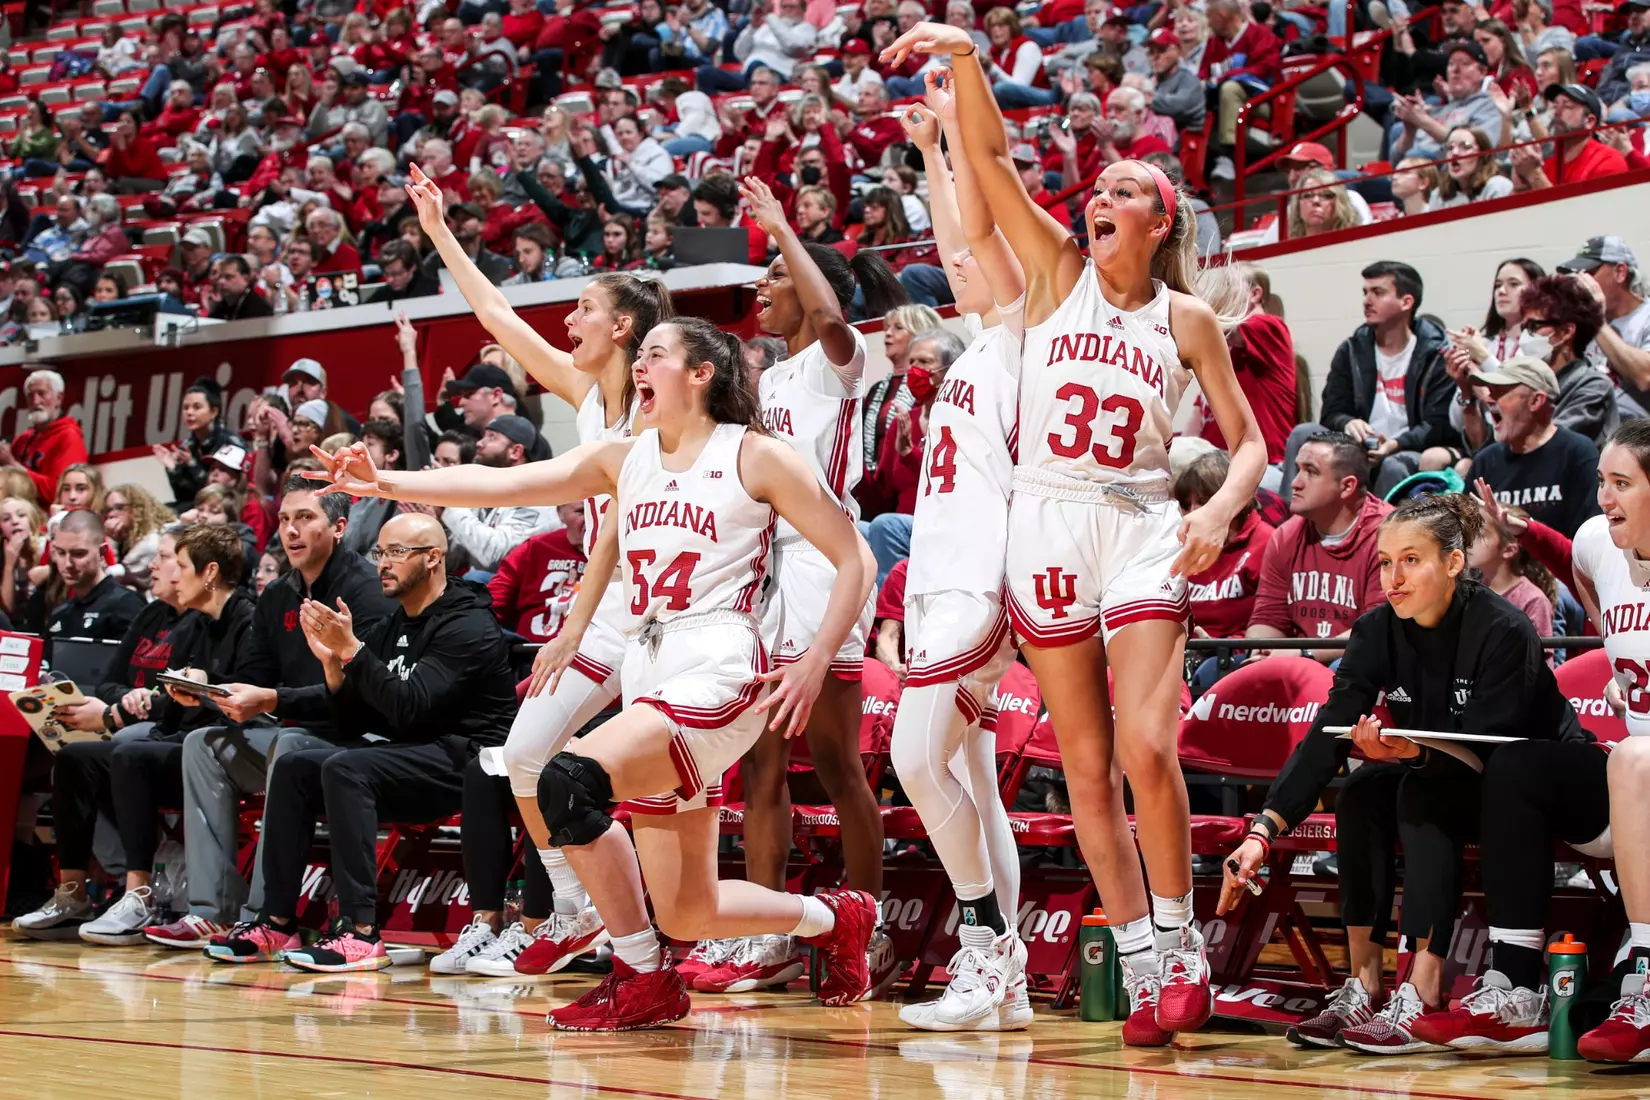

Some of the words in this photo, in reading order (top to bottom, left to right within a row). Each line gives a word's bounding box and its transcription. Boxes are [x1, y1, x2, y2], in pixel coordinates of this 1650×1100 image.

[1047, 333, 1164, 399] INDIANA
[1047, 382, 1145, 469] 33
[625, 500, 718, 544] NDIANA
[547, 559, 577, 571] GRACE
[626, 549, 701, 615] 54
[1083, 940, 1105, 965] G
[1209, 984, 1318, 1012] Vee
[1552, 970, 1575, 998] G
